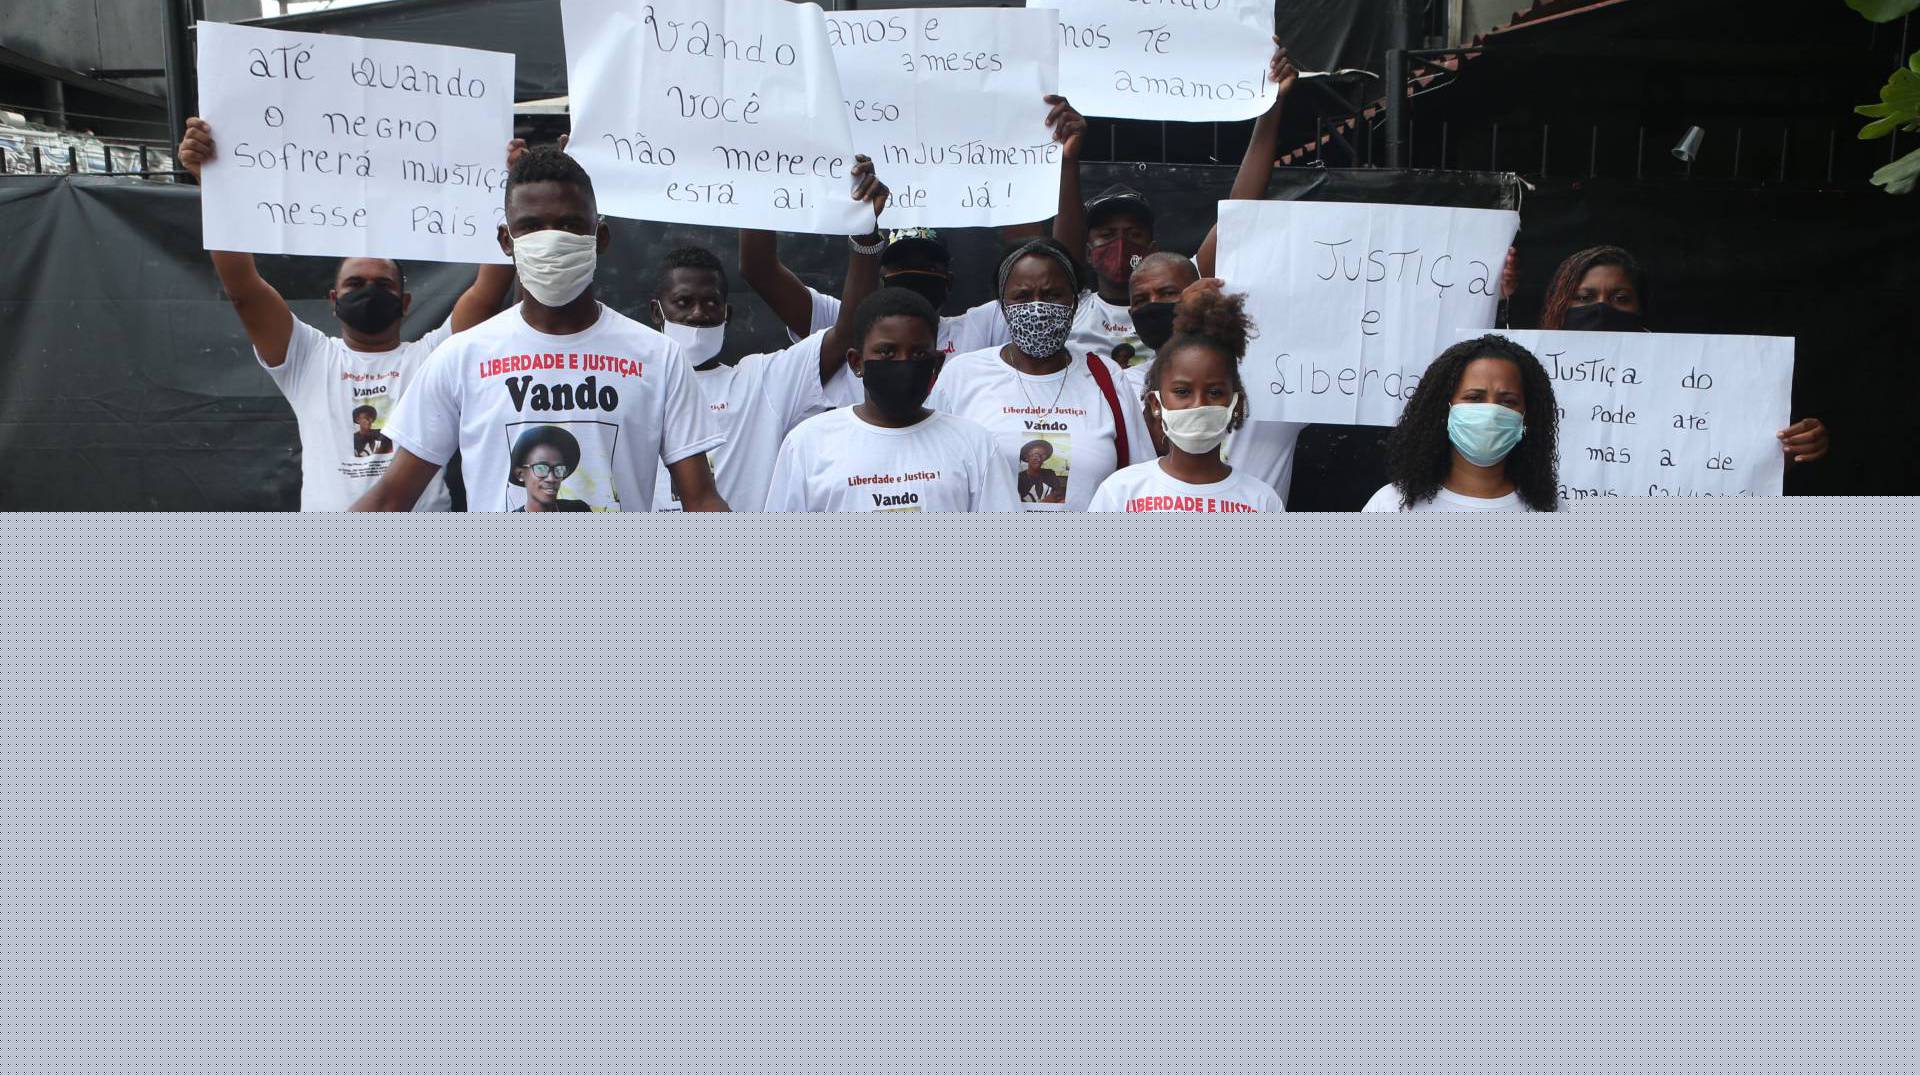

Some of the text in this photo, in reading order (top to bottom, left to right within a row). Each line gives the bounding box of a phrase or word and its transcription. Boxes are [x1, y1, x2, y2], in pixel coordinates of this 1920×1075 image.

[644, 5, 796, 66] Vando
[925, 18, 940, 41] e
[902, 52, 1003, 71] 3 meses
[603, 132, 843, 178] não merece
[257, 201, 368, 228] nesse
[1361, 310, 1381, 335] e
[480, 353, 643, 378] LIBERDADE E JUSTIÇA!
[1682, 366, 1713, 390] do
[353, 386, 386, 397] Vando
[505, 375, 619, 412] Vando
[1024, 420, 1068, 431] Vando
[1586, 447, 1735, 470] mas a de
[848, 474, 894, 486] Liberdade
[872, 492, 919, 506] Vando
